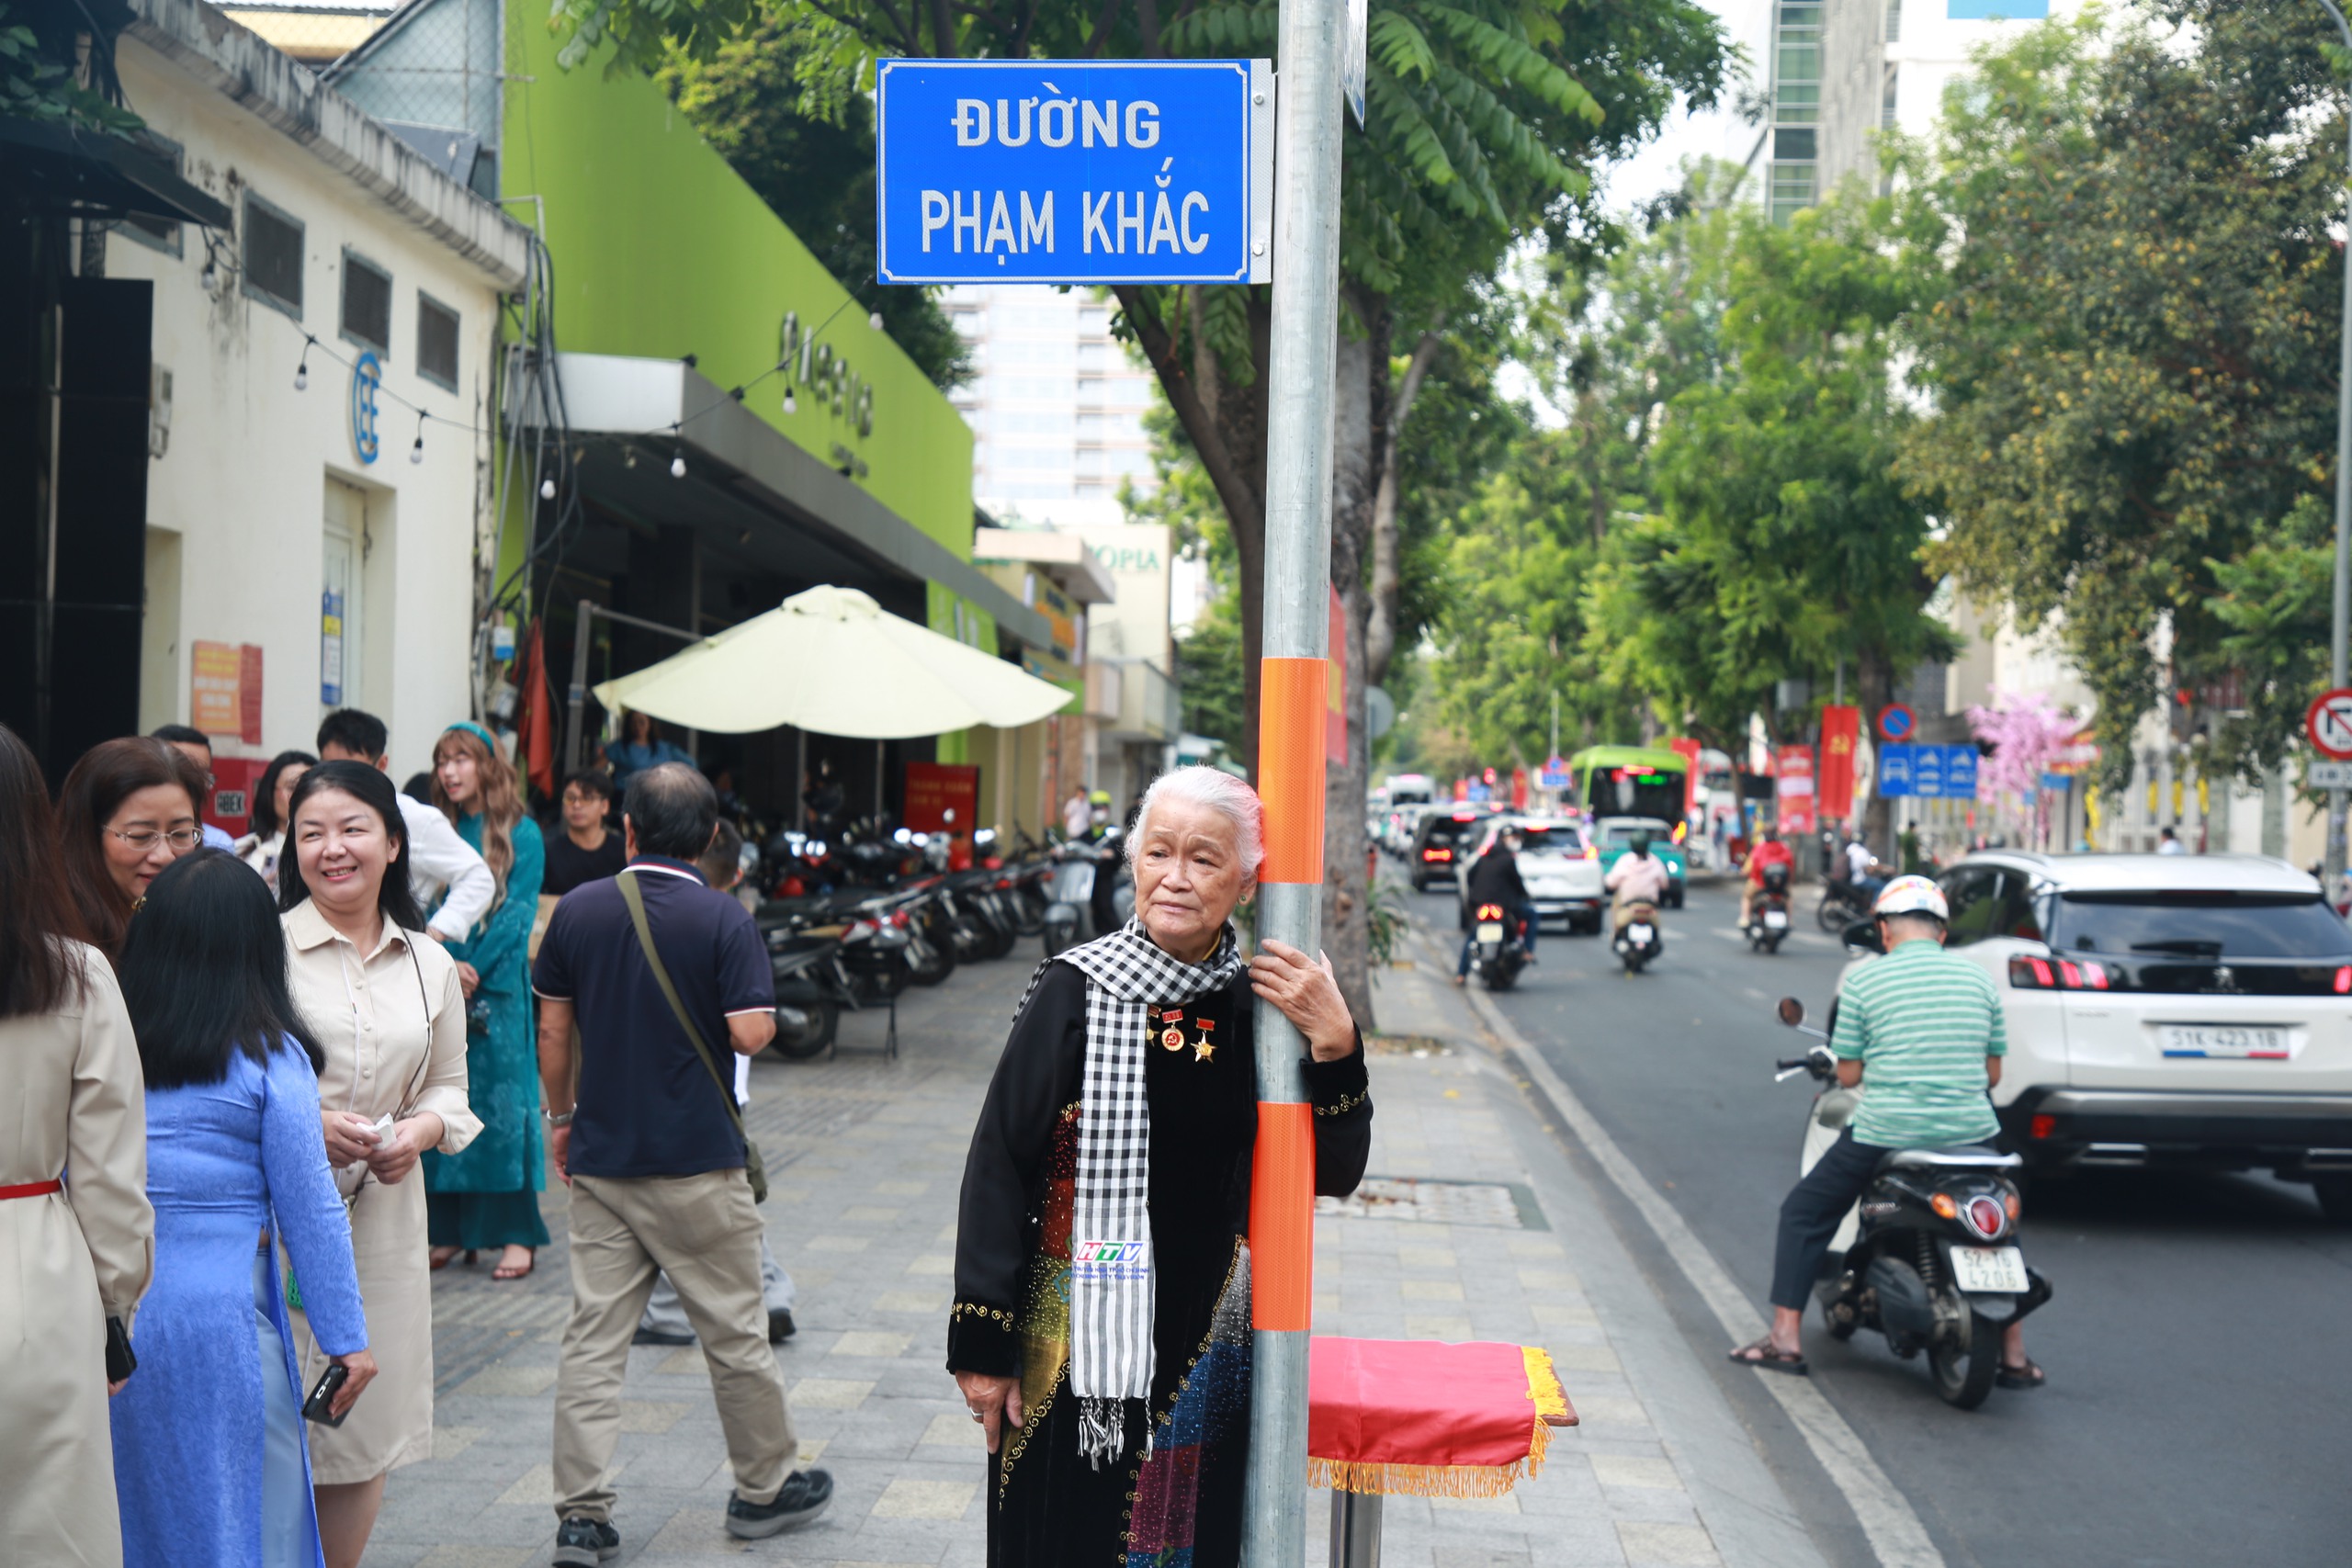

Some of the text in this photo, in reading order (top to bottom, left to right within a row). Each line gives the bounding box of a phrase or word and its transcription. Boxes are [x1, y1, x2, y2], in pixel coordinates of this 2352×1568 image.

[950, 81, 1160, 149] ĐƯỜNG
[921, 156, 1210, 265] PHẠM KHẮC
[1078, 1243, 1142, 1260] HTV
